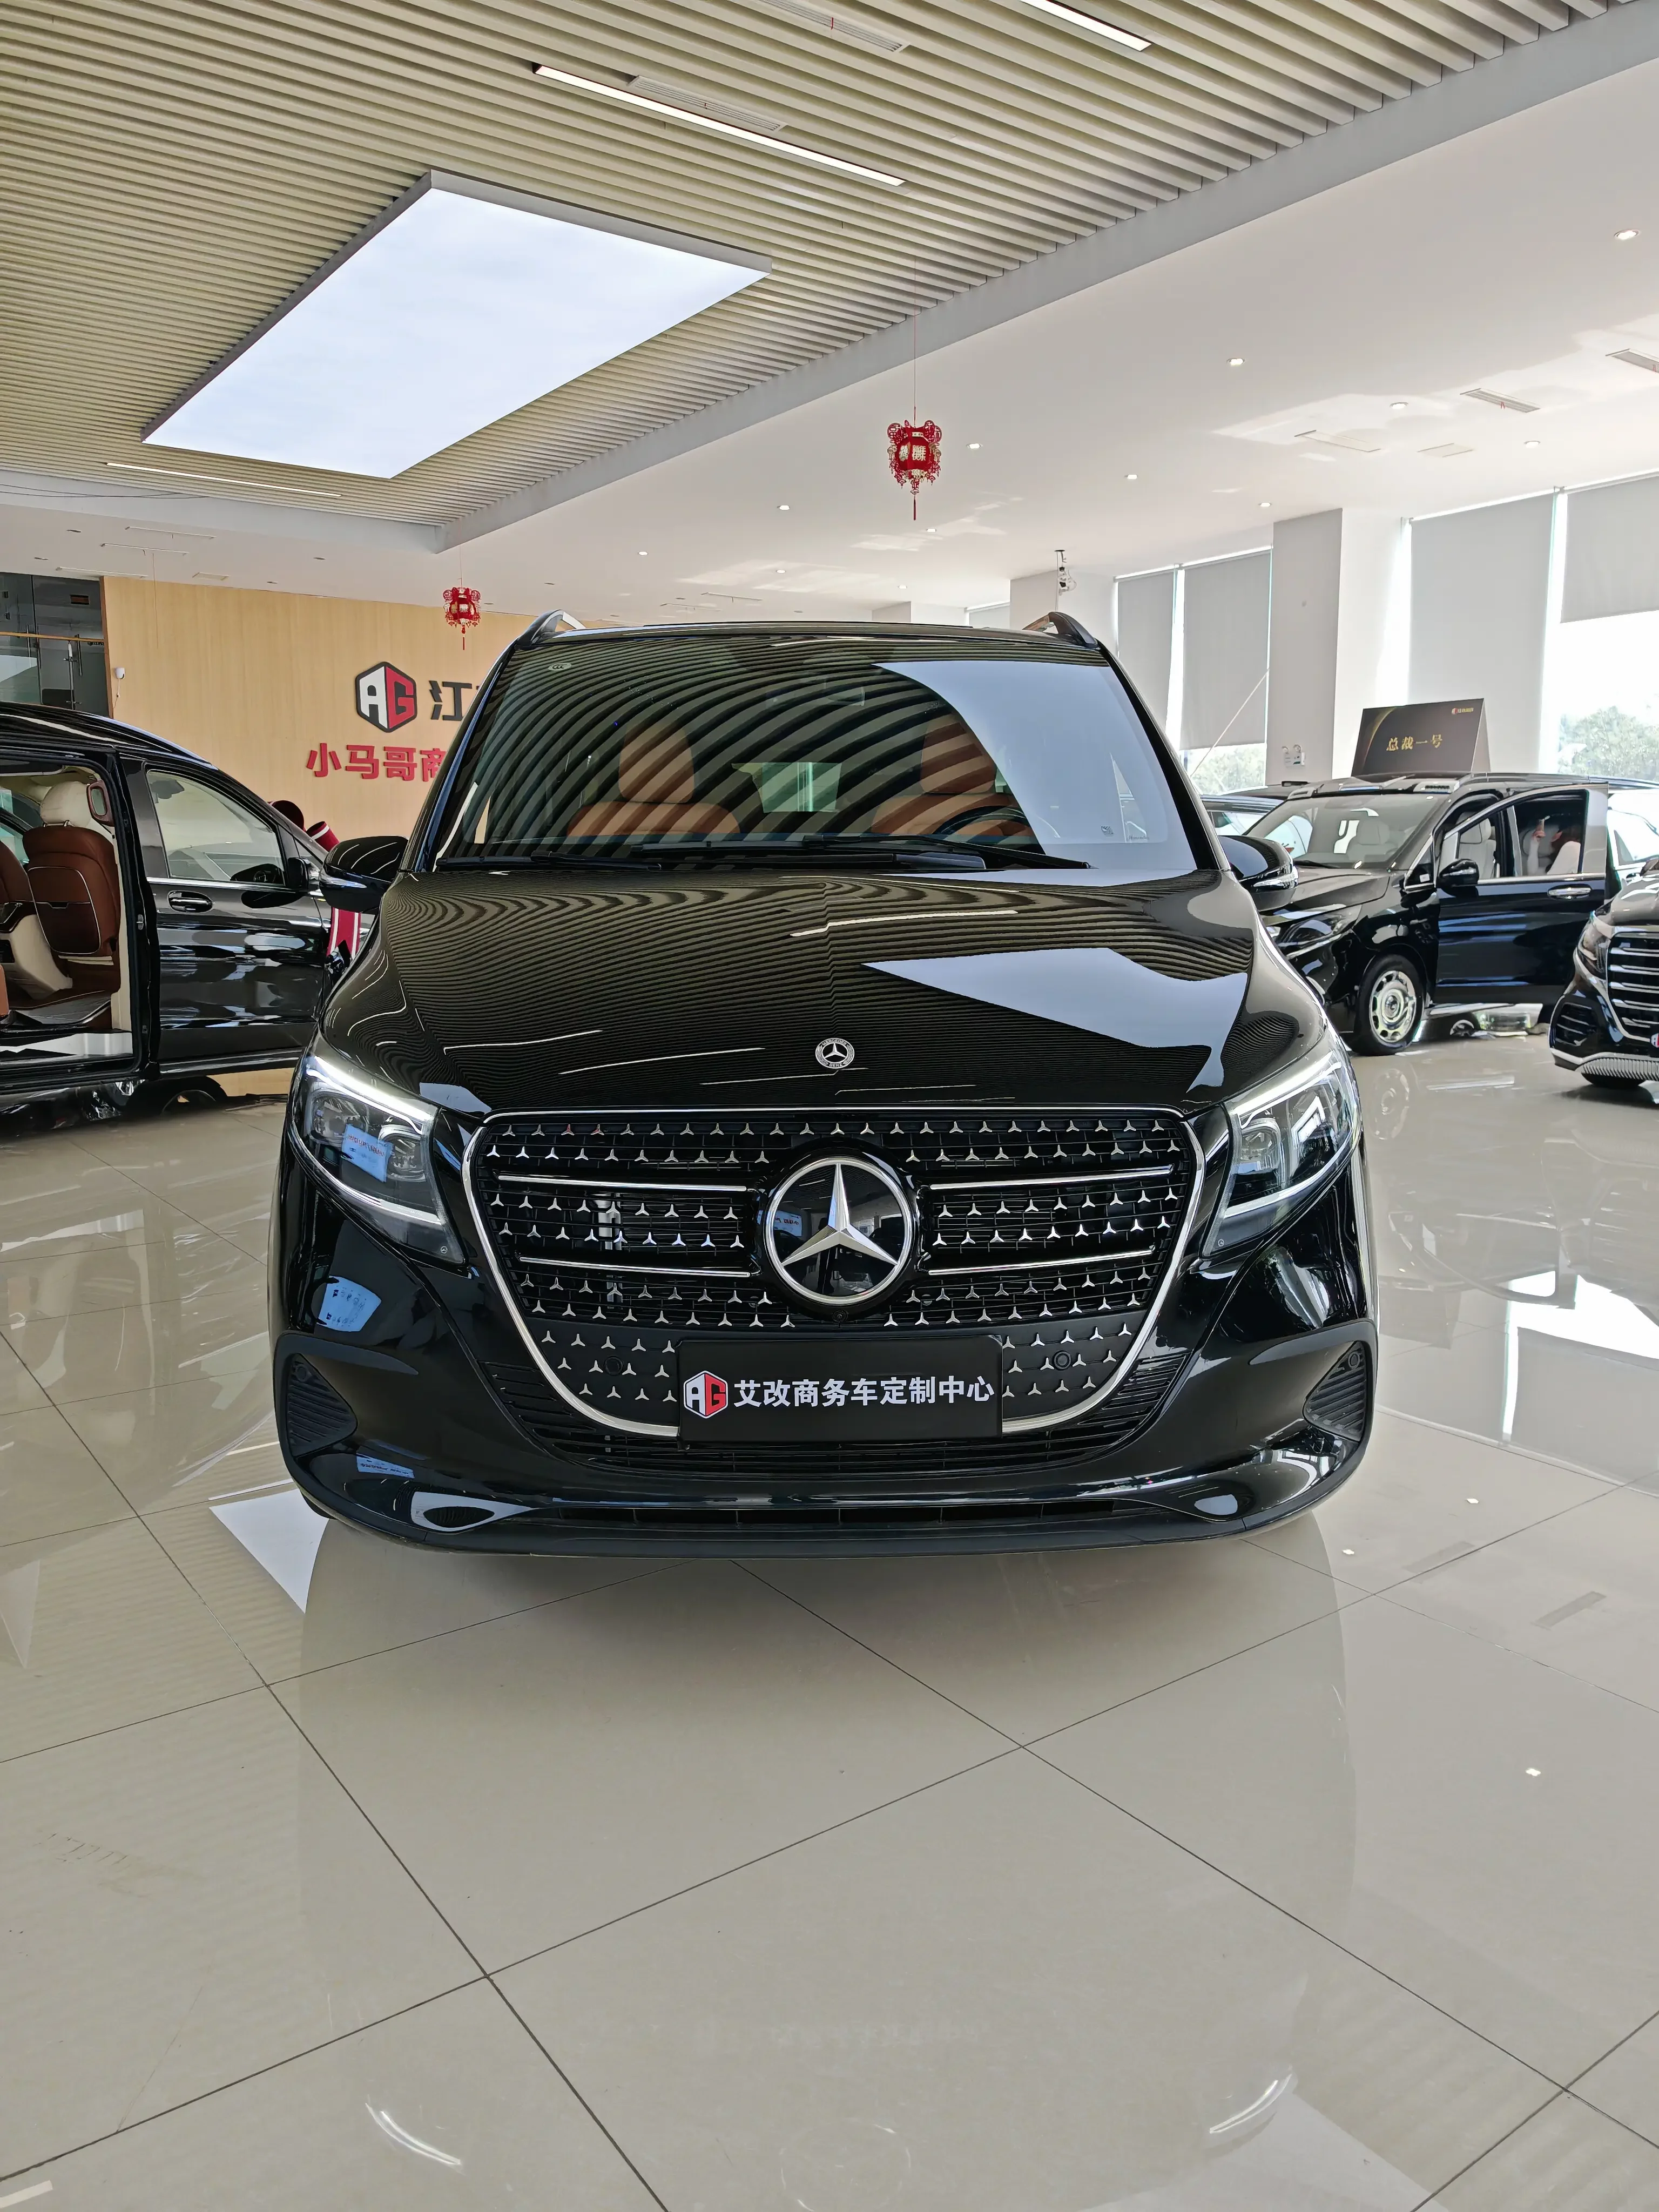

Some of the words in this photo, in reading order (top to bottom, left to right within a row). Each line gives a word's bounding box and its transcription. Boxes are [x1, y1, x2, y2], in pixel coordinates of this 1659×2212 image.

[428, 680, 480, 721] 江
[733, 1375, 995, 1407] 艾改商务车定制中心
